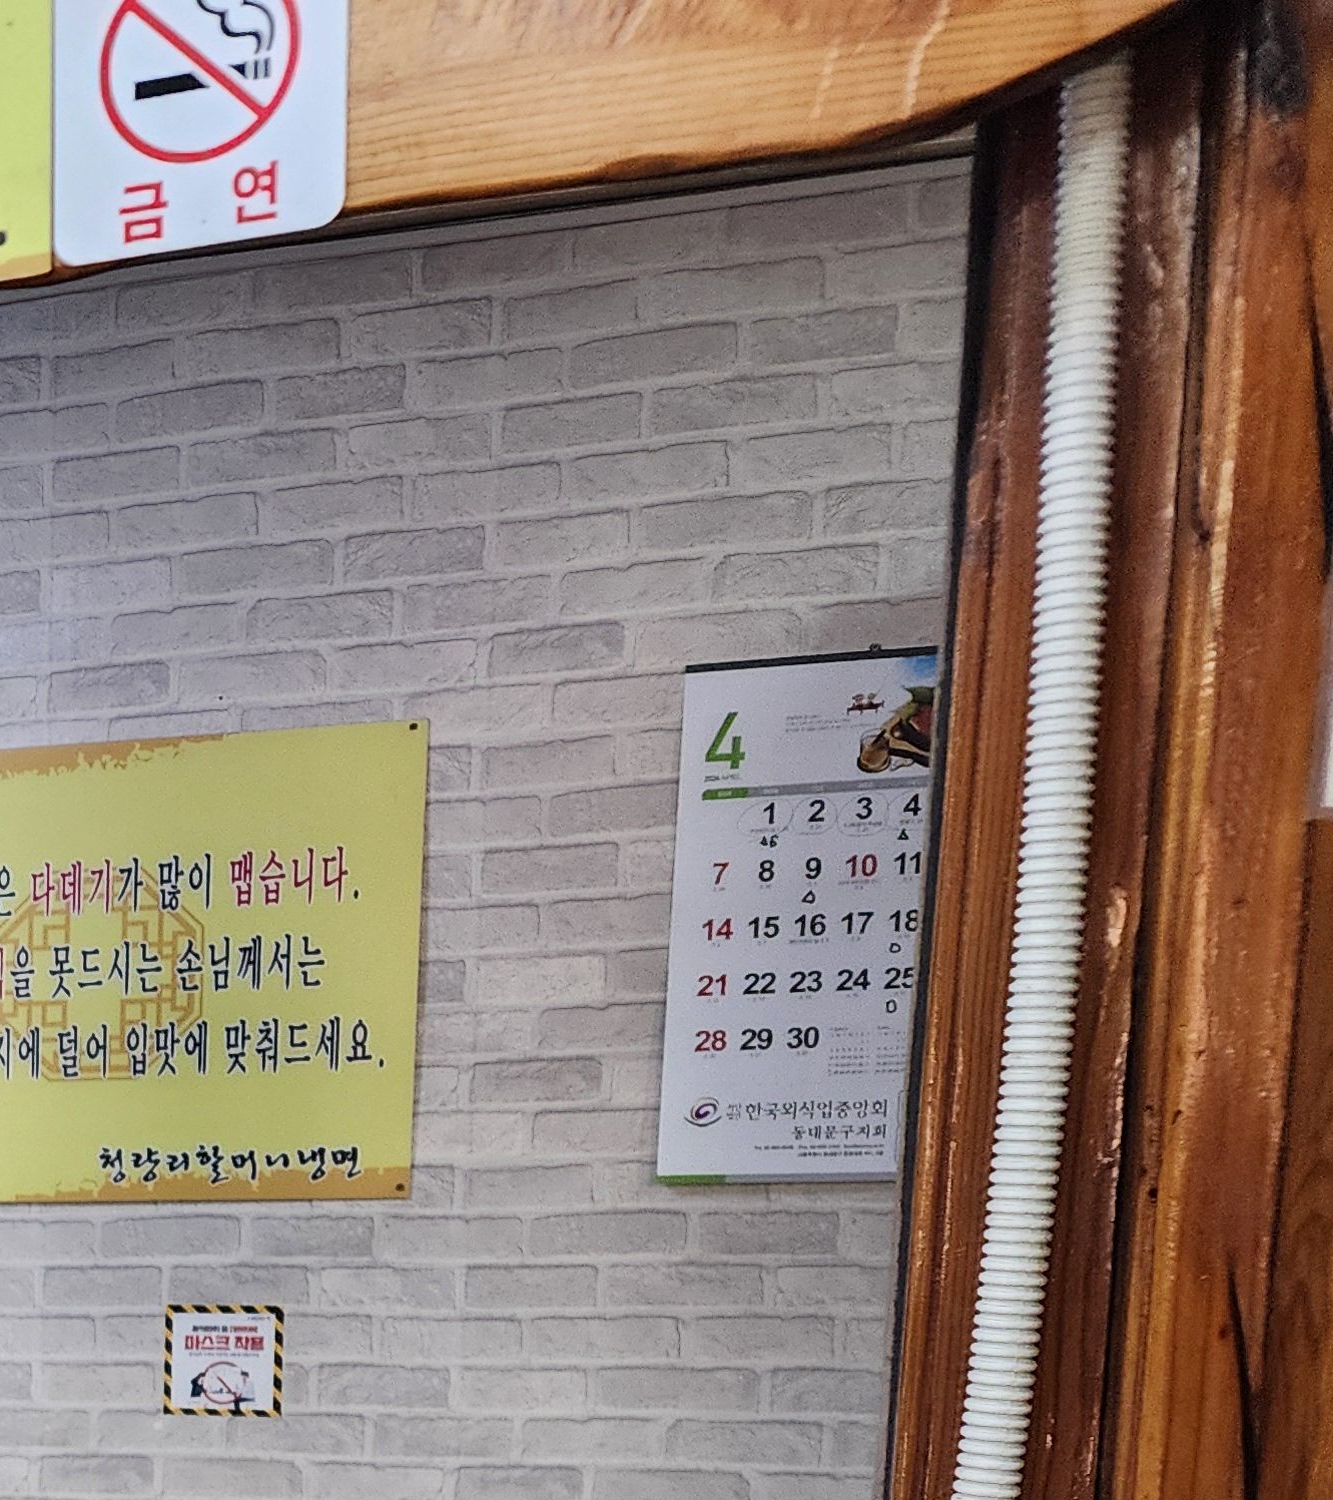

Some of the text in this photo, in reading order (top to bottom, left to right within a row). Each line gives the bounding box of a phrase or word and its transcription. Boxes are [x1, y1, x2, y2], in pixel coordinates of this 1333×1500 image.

[705, 712, 746, 770] 4
[763, 794, 921, 824] 1 2 3 4
[31, 857, 143, 917] 다데기가
[159, 853, 214, 911] 많이
[230, 846, 360, 908] 맵습니다.
[713, 852, 922, 885] 7 8 9 10 11
[702, 919, 733, 941] 14
[748, 916, 780, 939] 15
[794, 914, 826, 936] 16
[841, 912, 874, 934] 17
[49, 940, 164, 999] 못드시는
[175, 934, 327, 994] 손님께서는
[698, 967, 914, 996] 21 22 23 24 25
[57, 1024, 109, 1078] 덜어
[125, 1021, 209, 1078] 입맛에
[225, 1017, 385, 1075] 맞춰드세요.
[695, 1027, 820, 1052] 28 29 30
[746, 1099, 888, 1120] 한국외식업중앙회
